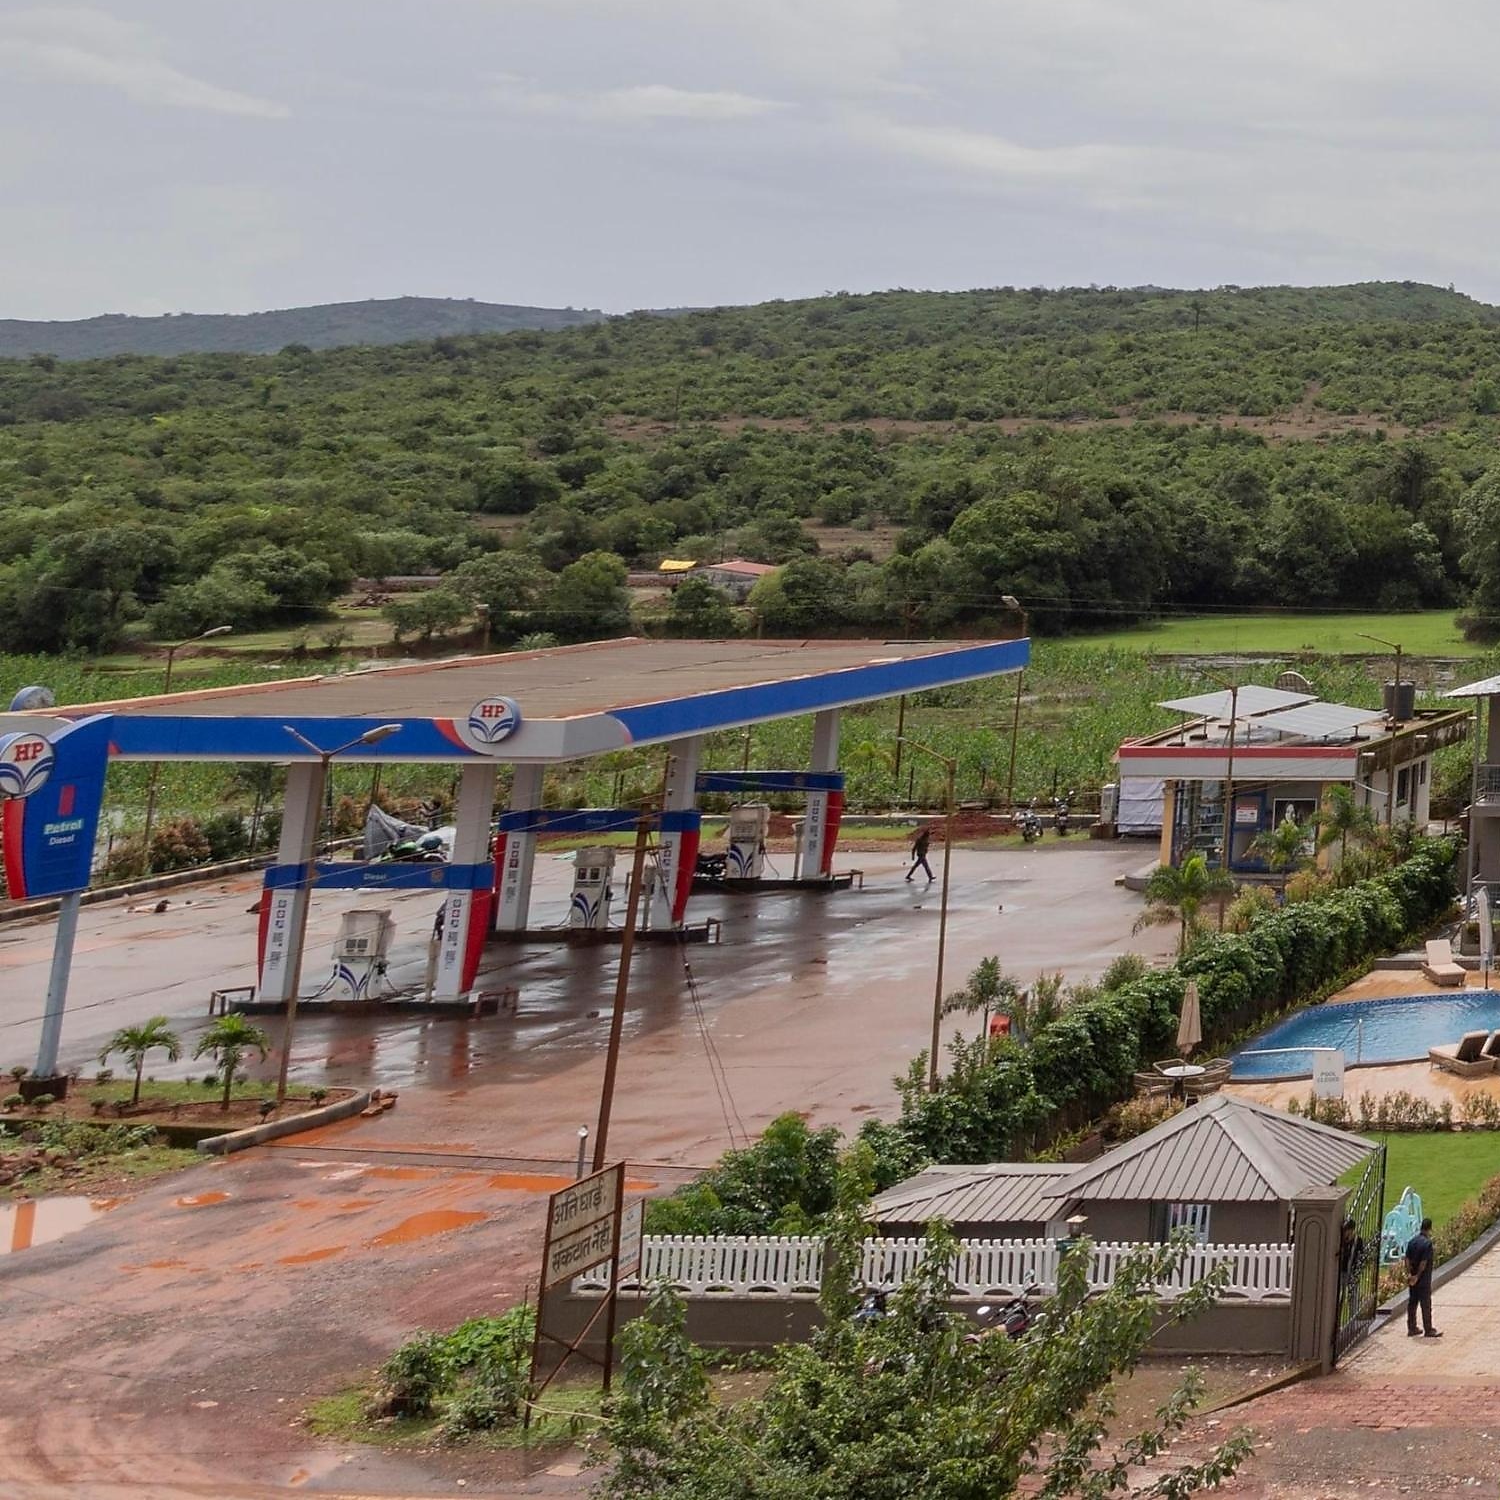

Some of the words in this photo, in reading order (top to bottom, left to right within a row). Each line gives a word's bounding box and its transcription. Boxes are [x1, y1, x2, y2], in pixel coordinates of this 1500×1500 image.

[480, 704, 505, 718] HP
[14, 741, 44, 762] HP
[43, 819, 83, 835] Petrol
[49, 834, 75, 845] Diesel
